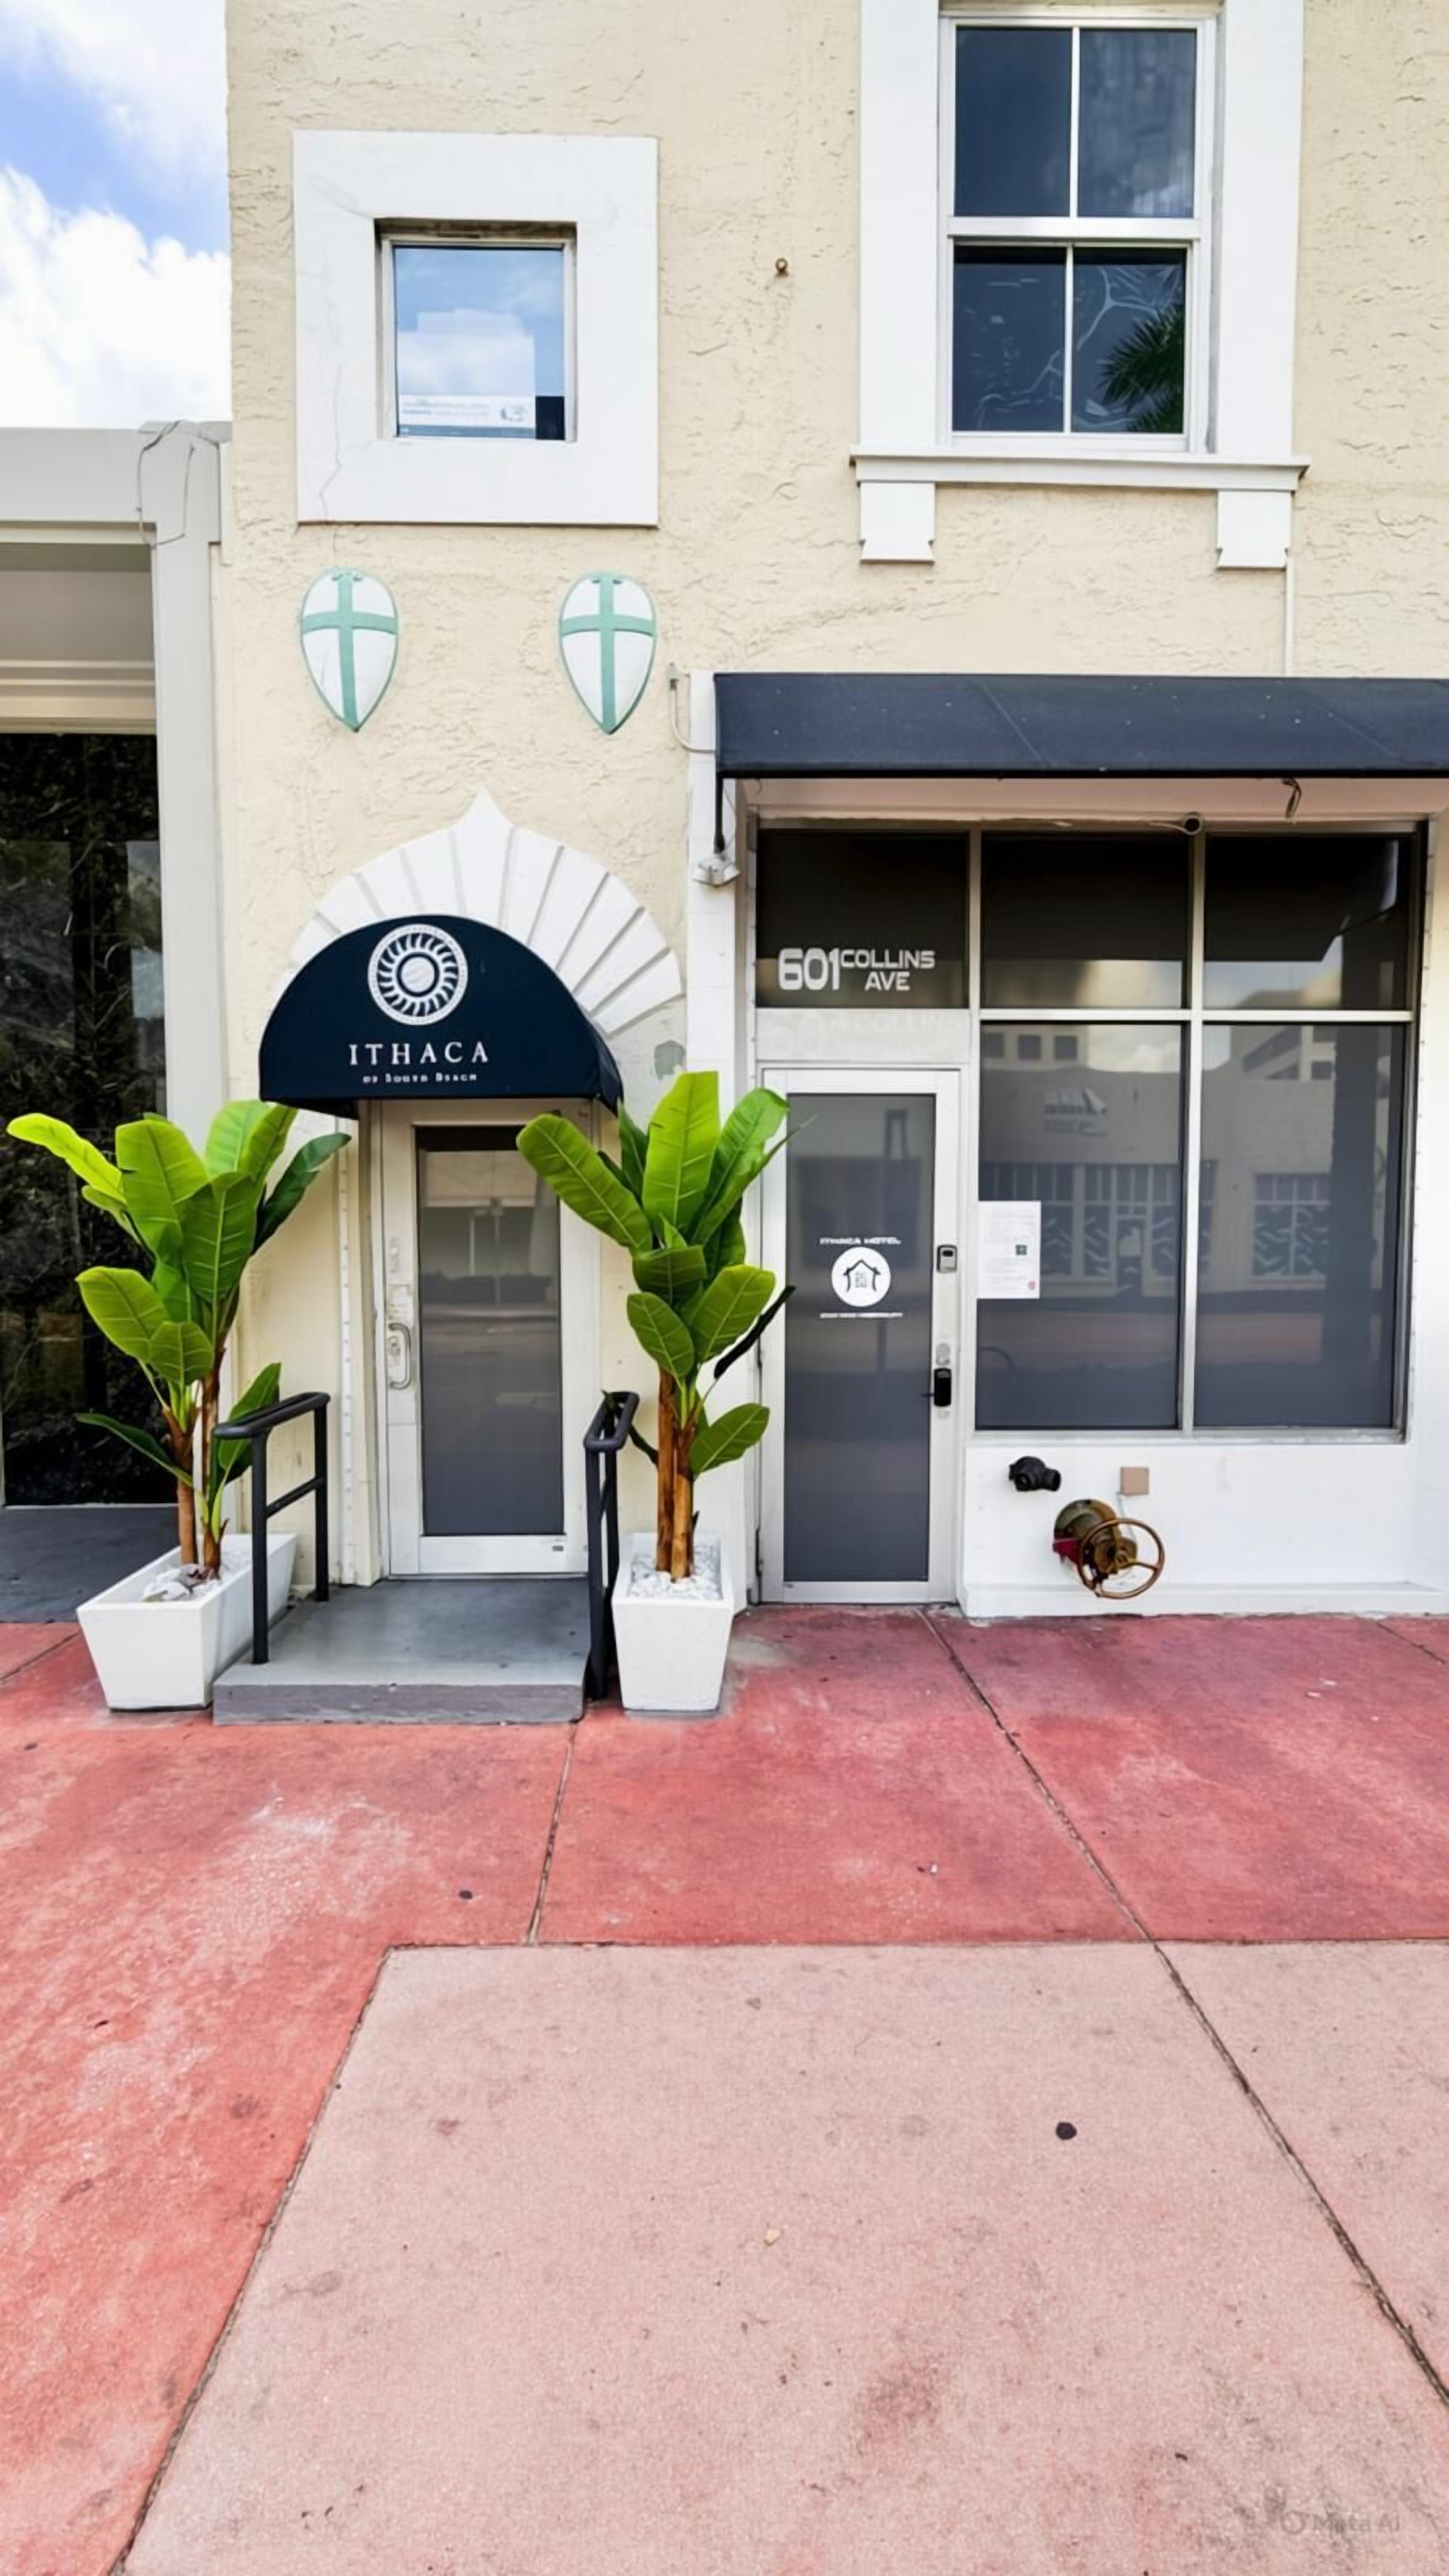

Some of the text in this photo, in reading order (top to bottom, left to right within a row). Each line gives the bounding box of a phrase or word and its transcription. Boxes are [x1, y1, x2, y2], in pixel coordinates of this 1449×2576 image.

[778, 948, 935, 991] 601 COLLINS
[865, 971, 910, 991] AVE
[349, 1041, 488, 1065] ITHACA
